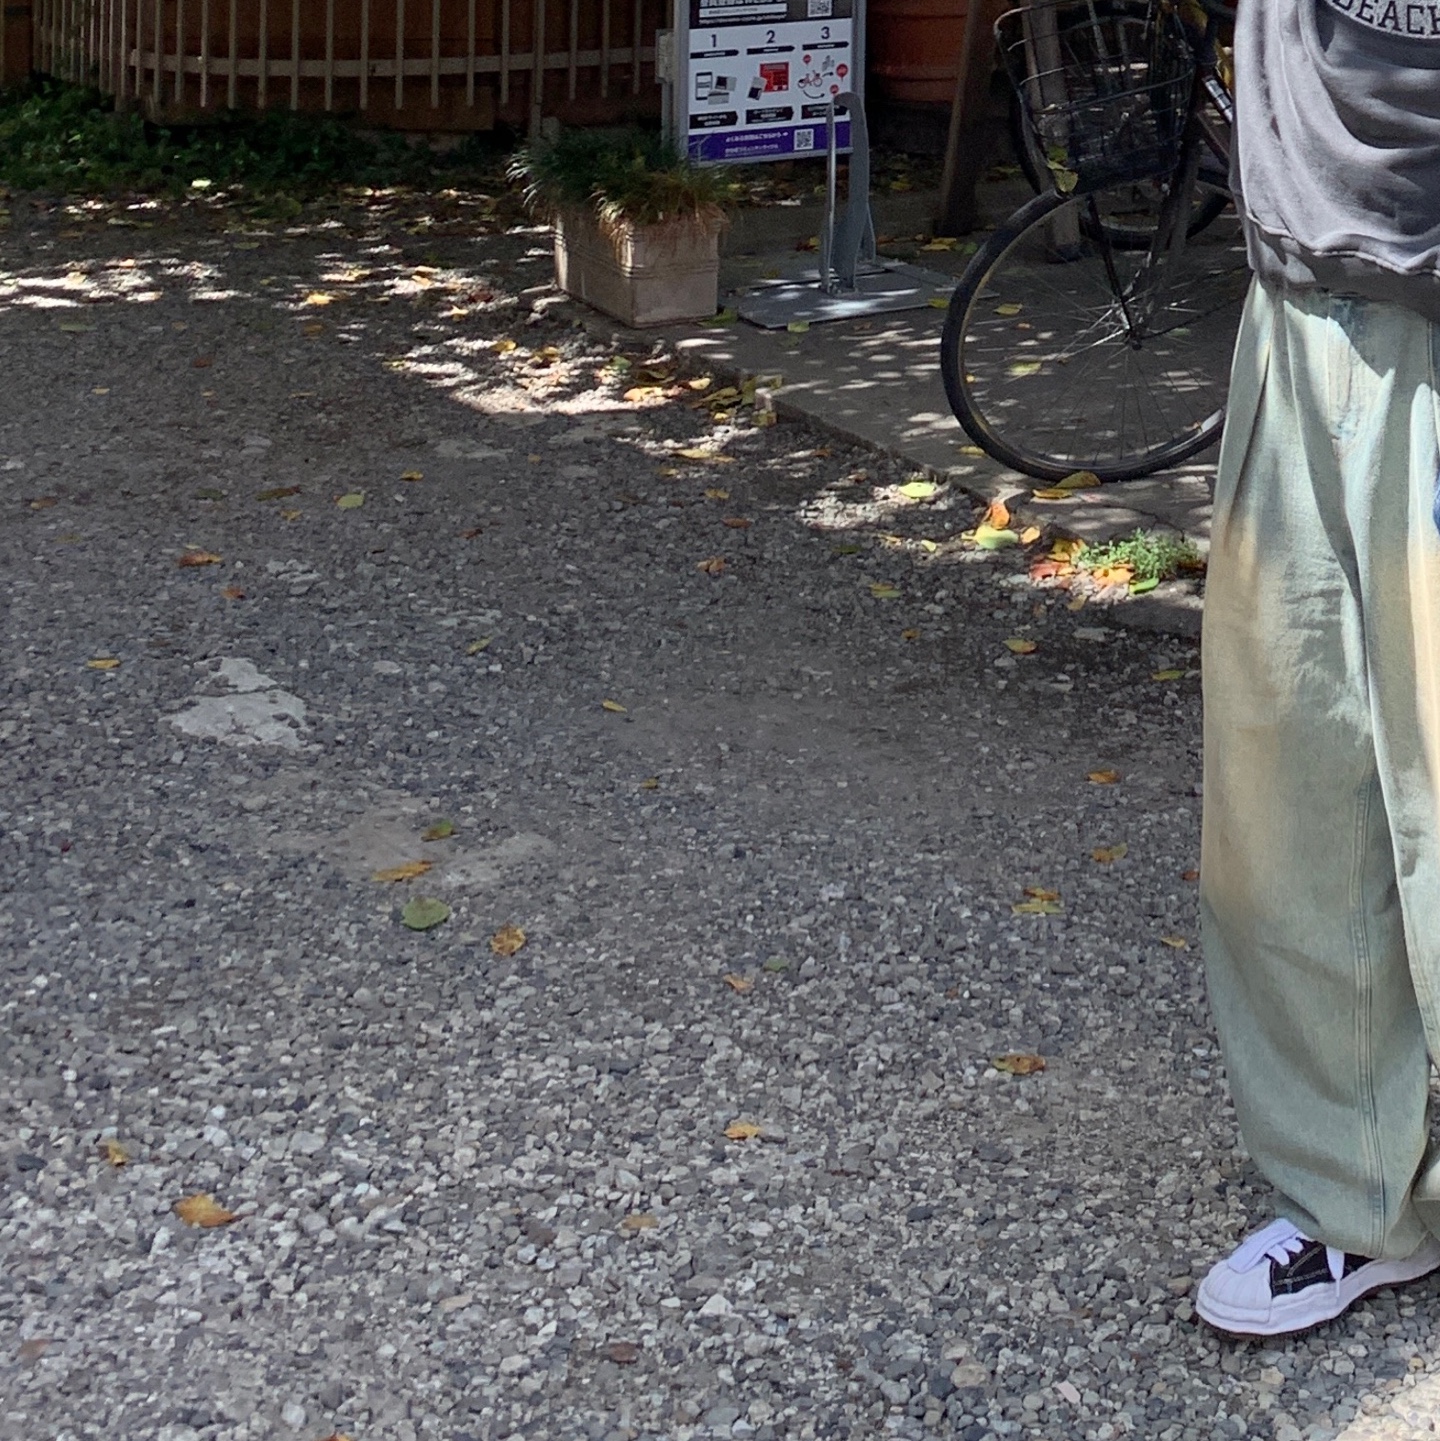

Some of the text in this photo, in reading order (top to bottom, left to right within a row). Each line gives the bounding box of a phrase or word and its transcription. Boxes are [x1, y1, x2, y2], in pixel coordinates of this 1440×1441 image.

[766, 30, 776, 44] 2
[820, 26, 831, 40] 3
[710, 34, 718, 48] 1
